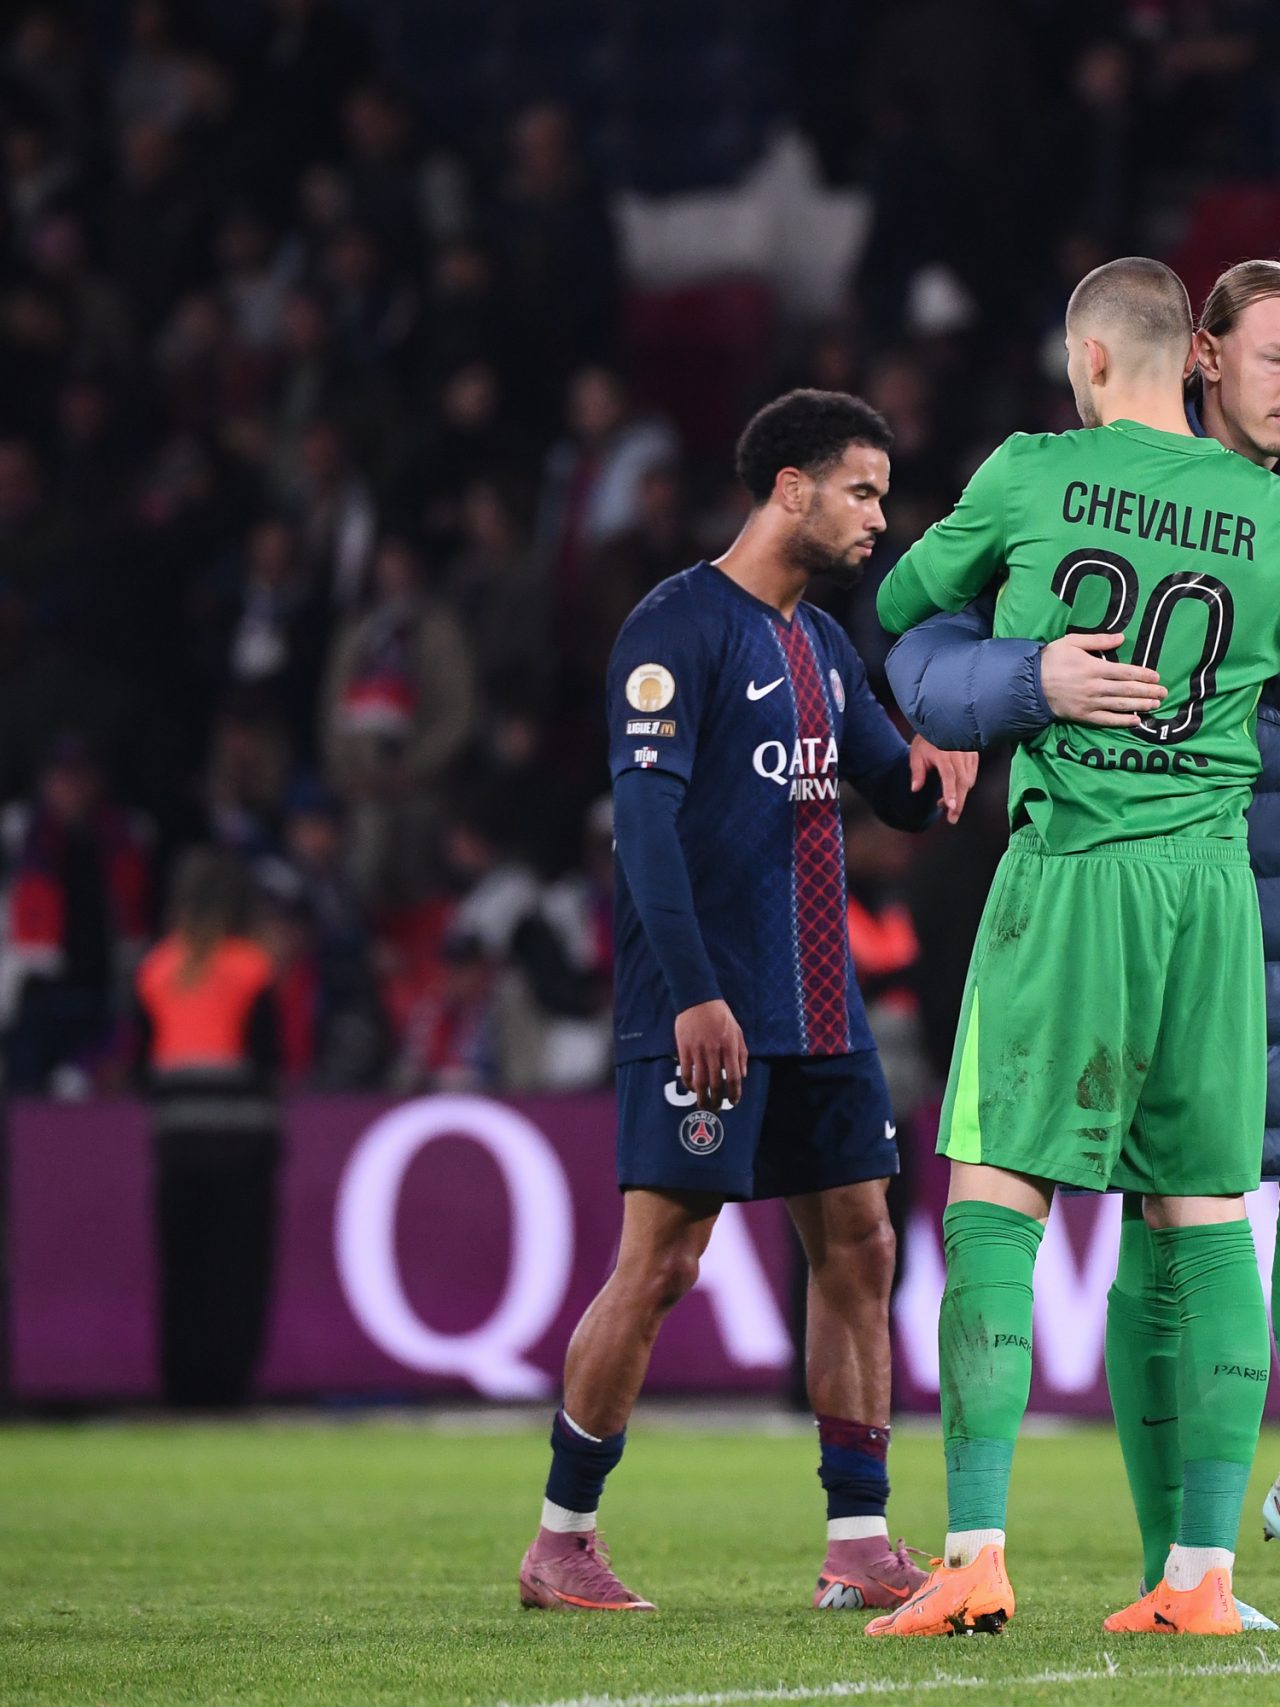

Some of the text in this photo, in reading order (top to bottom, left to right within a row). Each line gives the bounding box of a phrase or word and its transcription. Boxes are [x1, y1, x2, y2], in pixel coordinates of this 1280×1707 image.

[1062, 480, 1257, 562] CHEVALIER
[752, 737, 839, 786] QATA
[788, 778, 841, 801] AIRW
[994, 1334, 1032, 1351] PARI
[1214, 1364, 1268, 1382] PARIS
